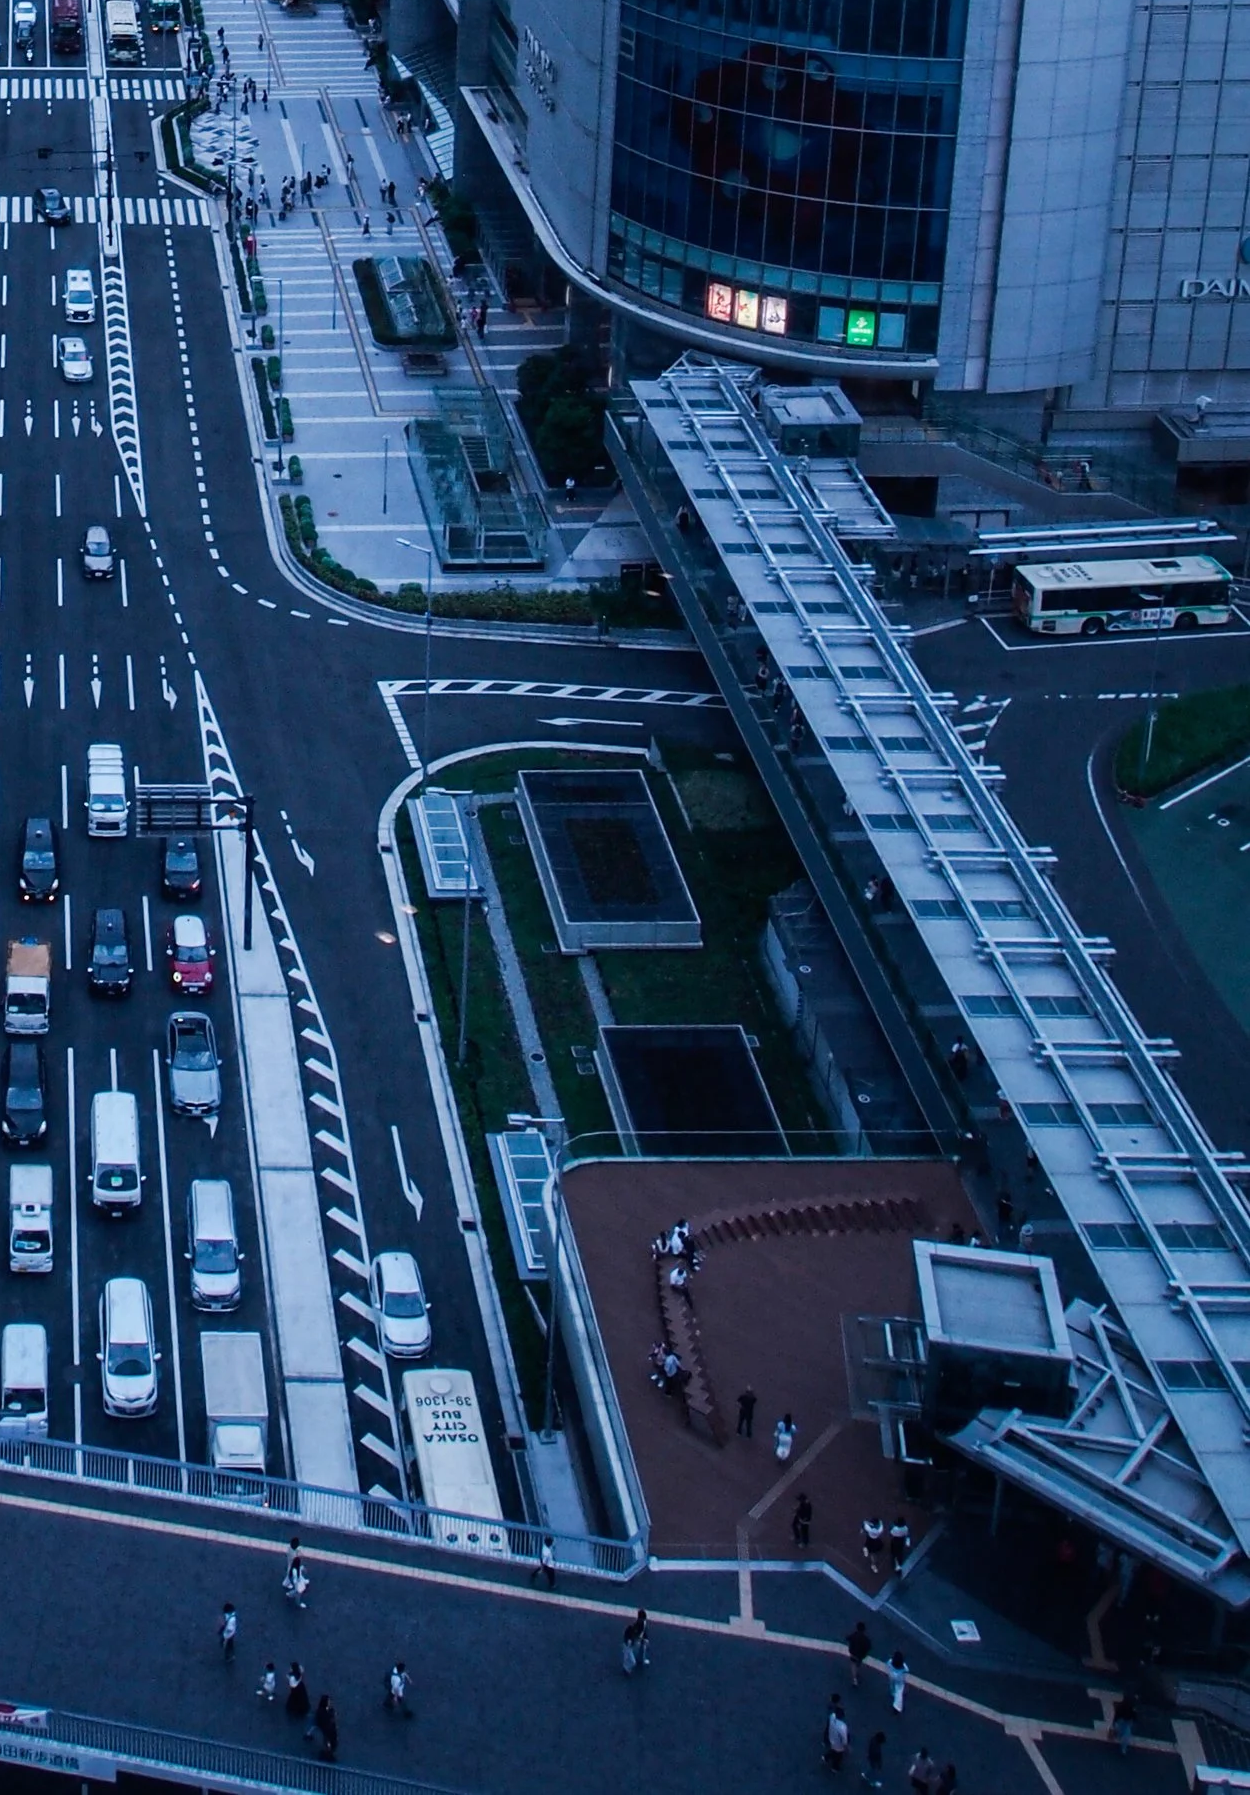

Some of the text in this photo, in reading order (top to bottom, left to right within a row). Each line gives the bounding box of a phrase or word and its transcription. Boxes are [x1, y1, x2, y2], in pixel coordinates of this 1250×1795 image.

[415, 1396, 472, 1407] 39-1306
[431, 1410, 462, 1419] BUS
[432, 1422, 467, 1431] CITY
[423, 1433, 479, 1443] OSAKA
